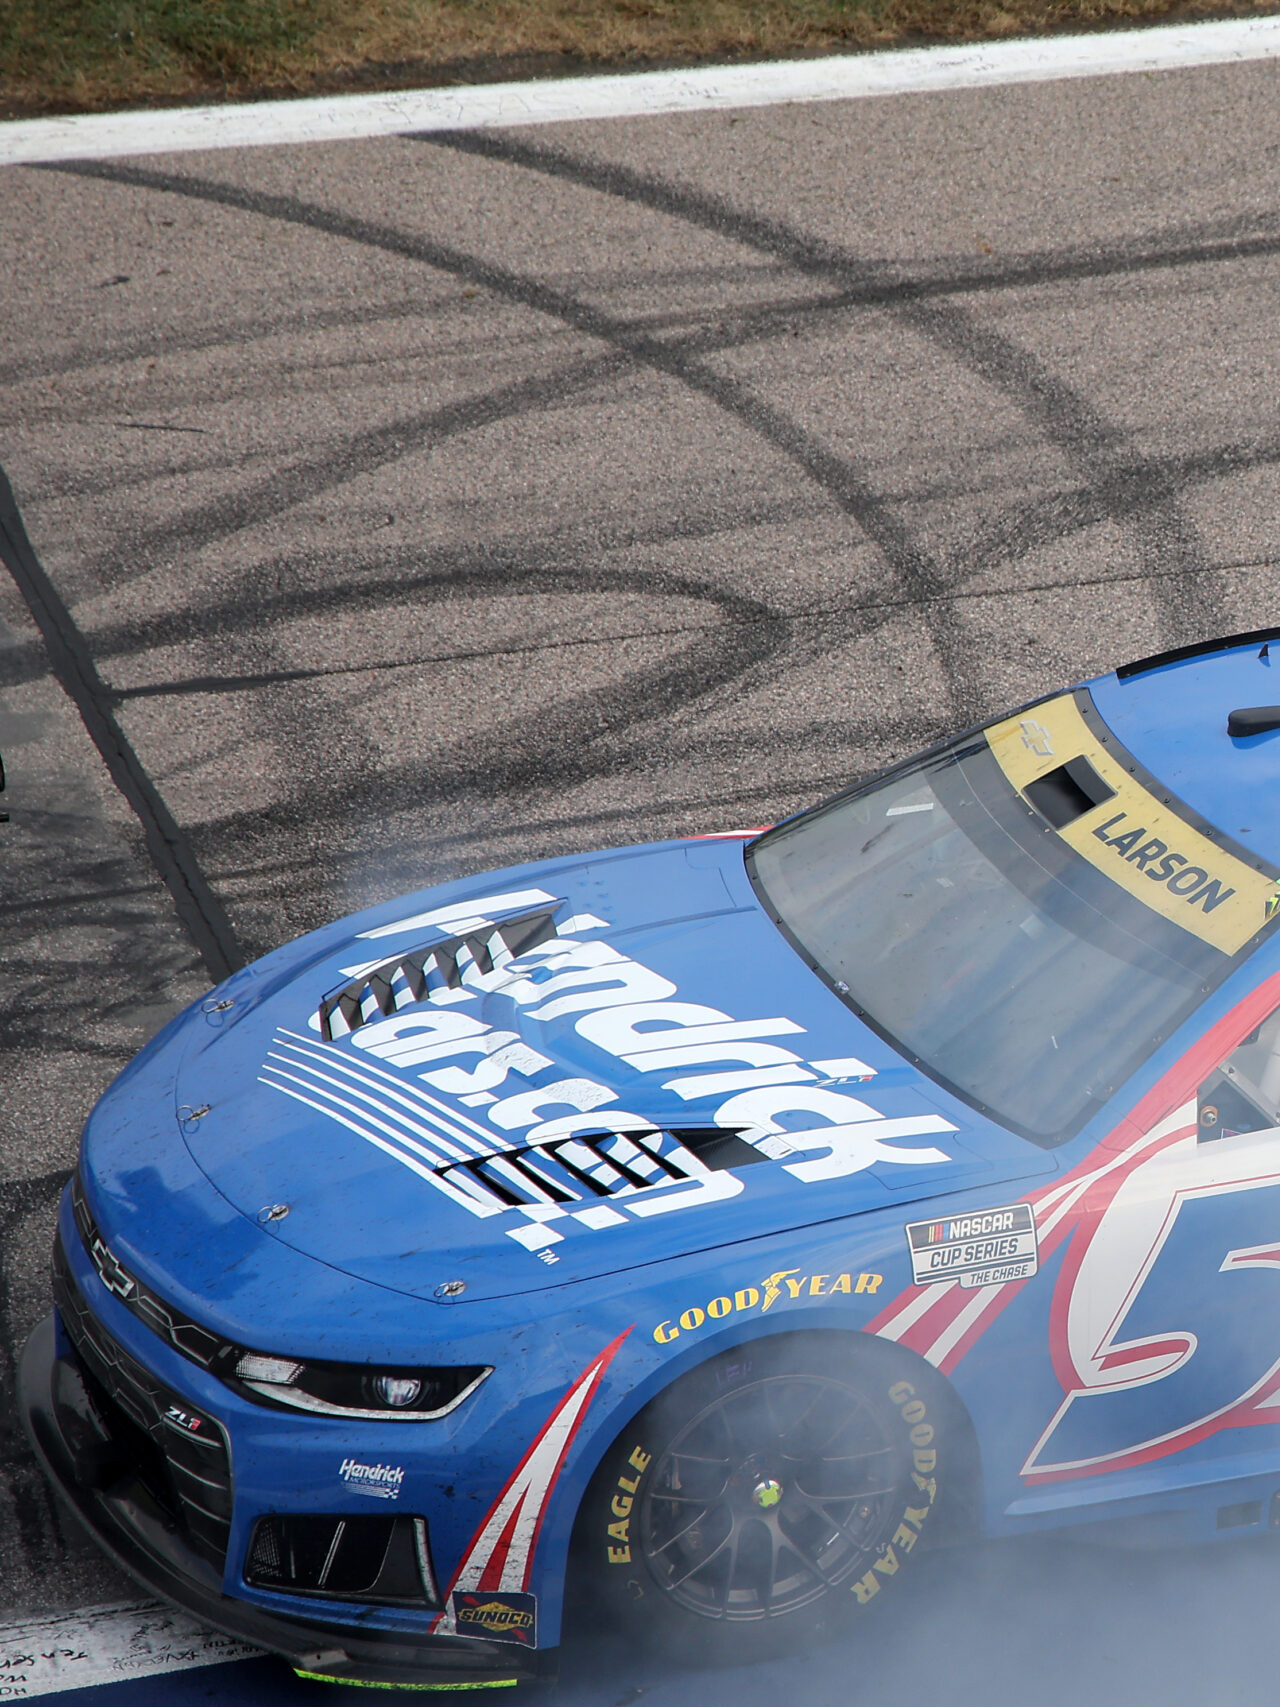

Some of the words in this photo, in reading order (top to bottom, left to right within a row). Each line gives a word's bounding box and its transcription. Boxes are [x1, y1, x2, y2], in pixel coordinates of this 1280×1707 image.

[1091, 812, 1236, 914] LARSON
[949, 1211, 1014, 1241] NASCAR
[930, 1247, 962, 1269] CUP
[963, 1237, 1019, 1262] SERIES
[970, 1270, 990, 1285] THE
[992, 1264, 1028, 1281] CHASE
[338, 1458, 405, 1484] Hendrick
[349, 1476, 401, 1489] MOTORSPORTS
[608, 1446, 652, 1564] EAGLE
[459, 1610, 532, 1628] SUNOCO
